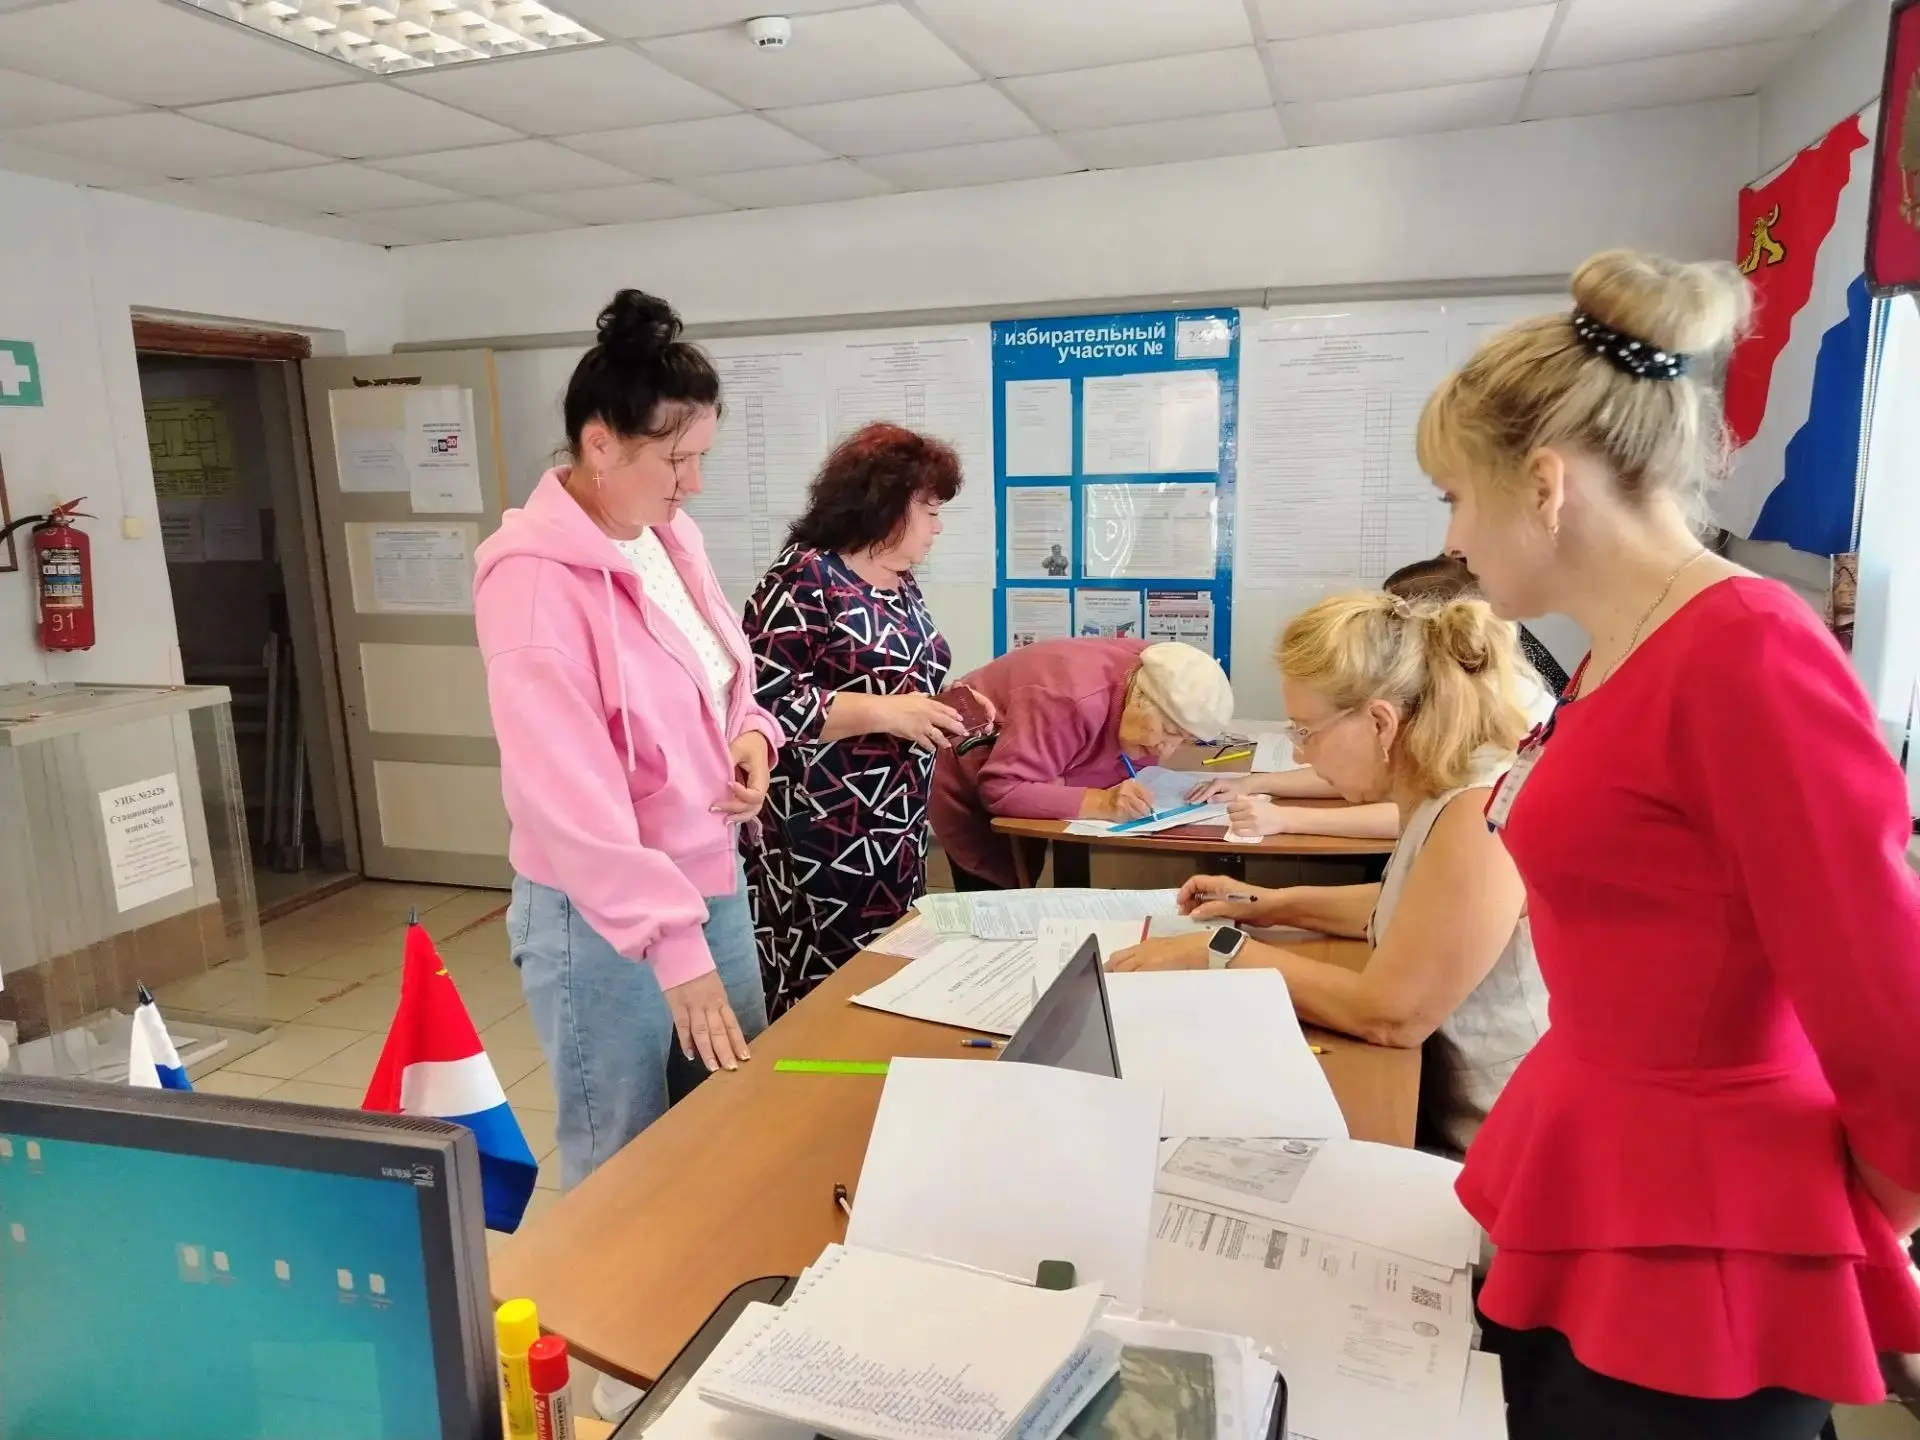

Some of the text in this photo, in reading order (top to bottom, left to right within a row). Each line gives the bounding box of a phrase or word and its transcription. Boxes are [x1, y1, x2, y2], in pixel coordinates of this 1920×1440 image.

[1005, 321, 1166, 347] избирательный
[1058, 340, 1164, 364] участок №
[52, 611, 74, 632] 91
[114, 793, 137, 807] УИК
[110, 800, 174, 825] Стационарный
